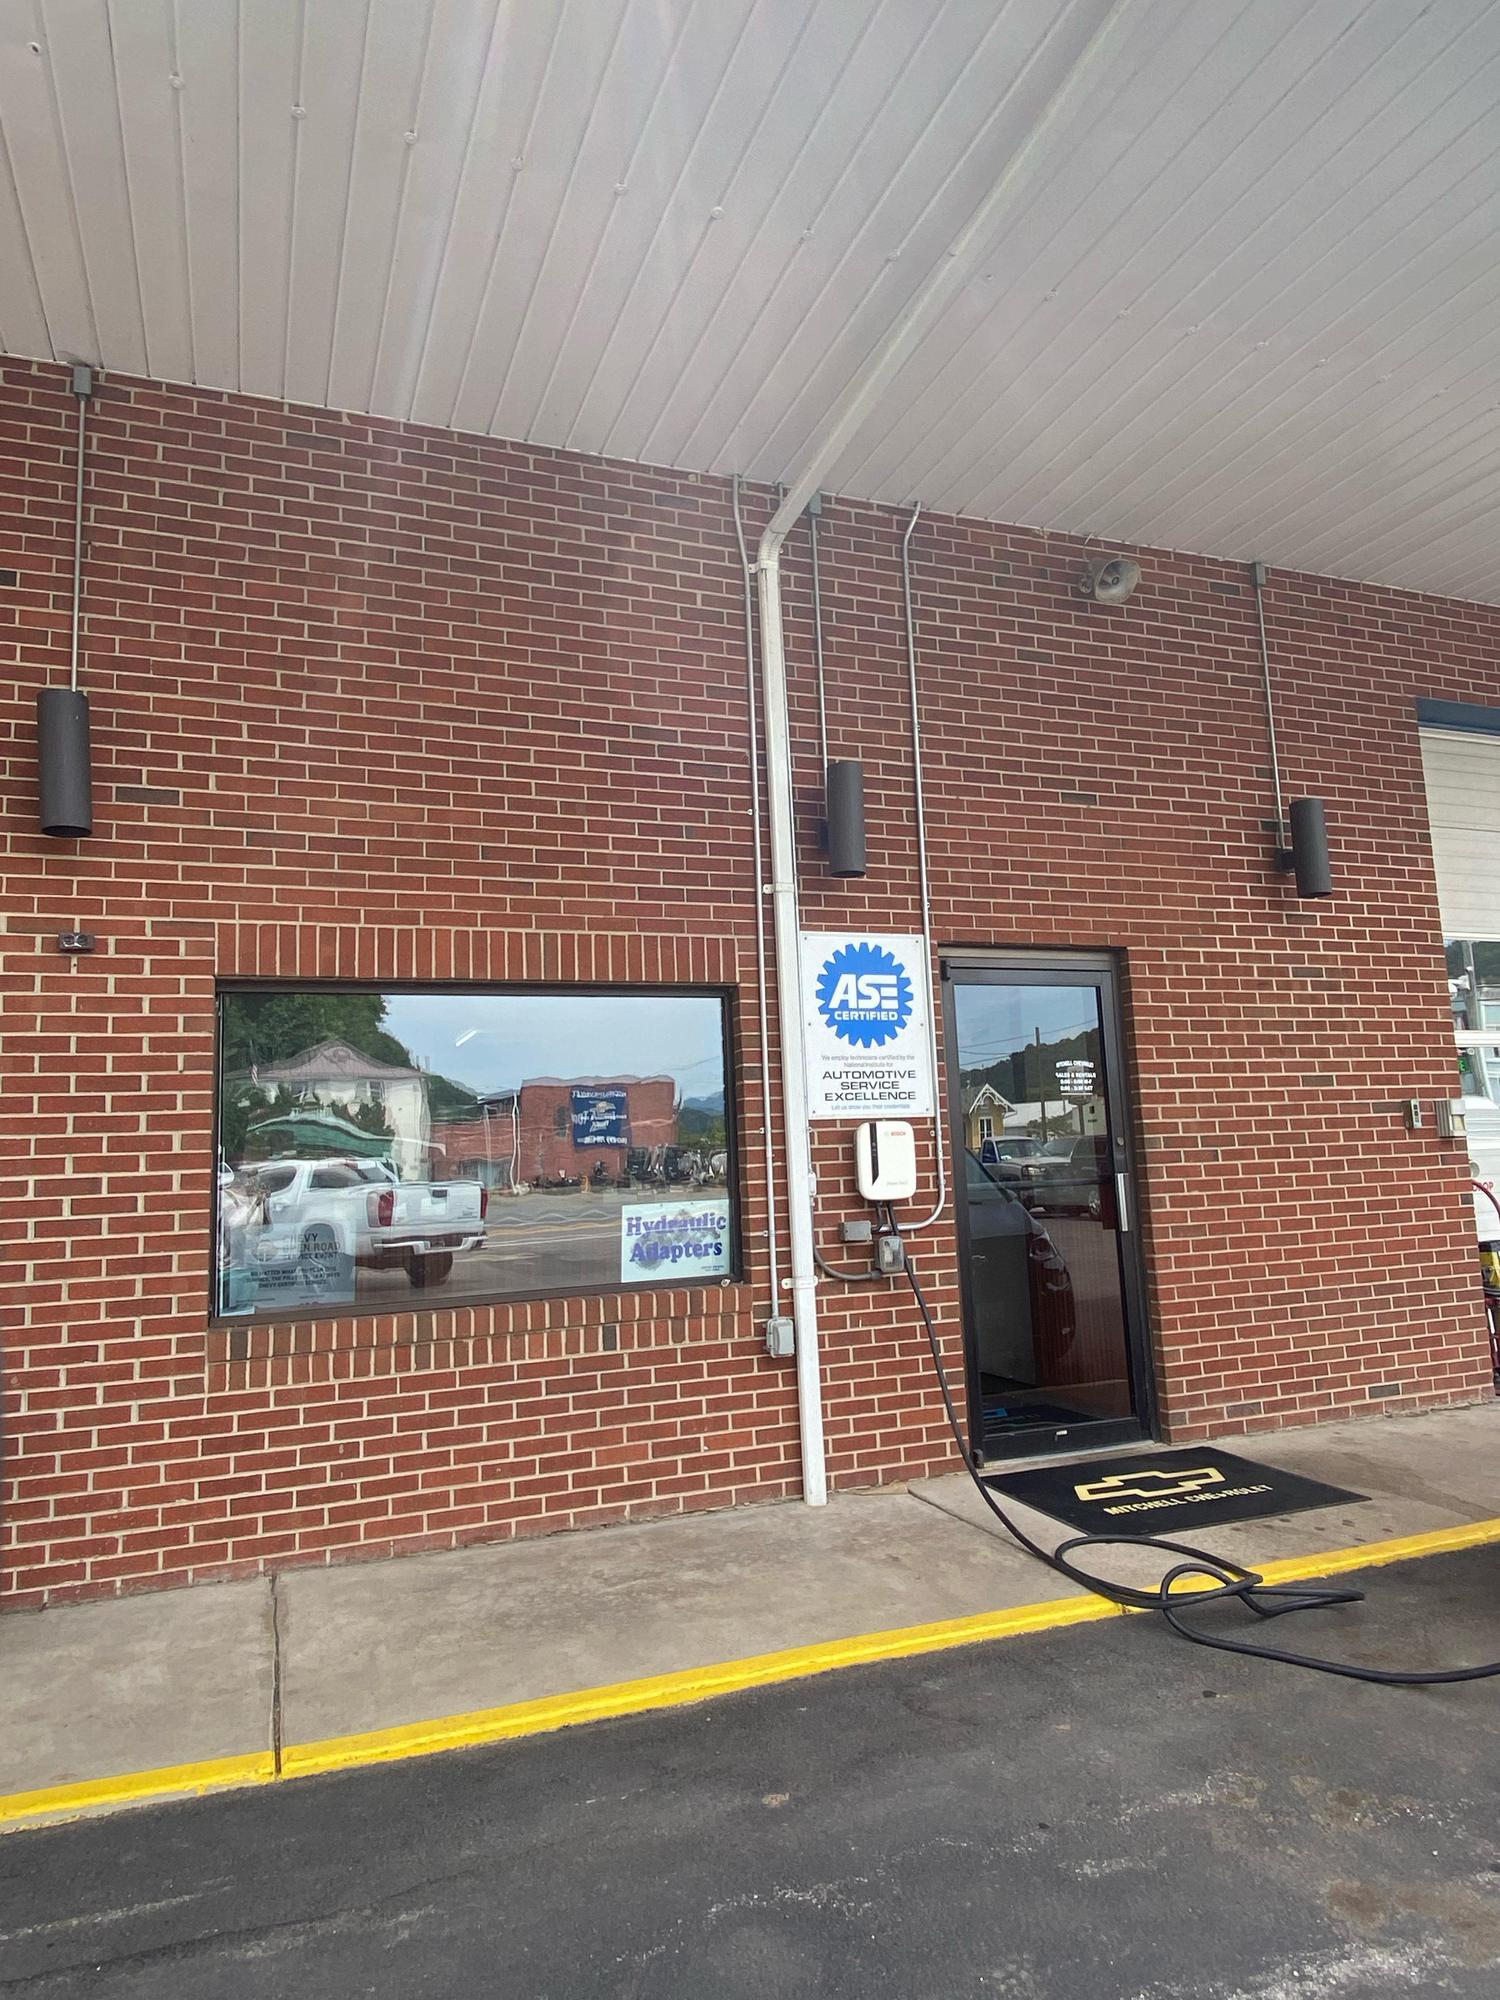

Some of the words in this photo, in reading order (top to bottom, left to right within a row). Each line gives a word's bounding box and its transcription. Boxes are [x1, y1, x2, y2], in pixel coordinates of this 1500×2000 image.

[829, 974, 899, 1009] ASE
[834, 1011, 898, 1021] CERTIFIED
[822, 1070, 916, 1079] AUTOMOTIVE
[841, 1081, 899, 1090] SERVICE
[825, 1091, 916, 1101] EXCELLENCE
[629, 1241, 723, 1263] Adapters
[1103, 1498, 1187, 1515] MITCHELL
[1184, 1485, 1273, 1503] CHEVROLET
